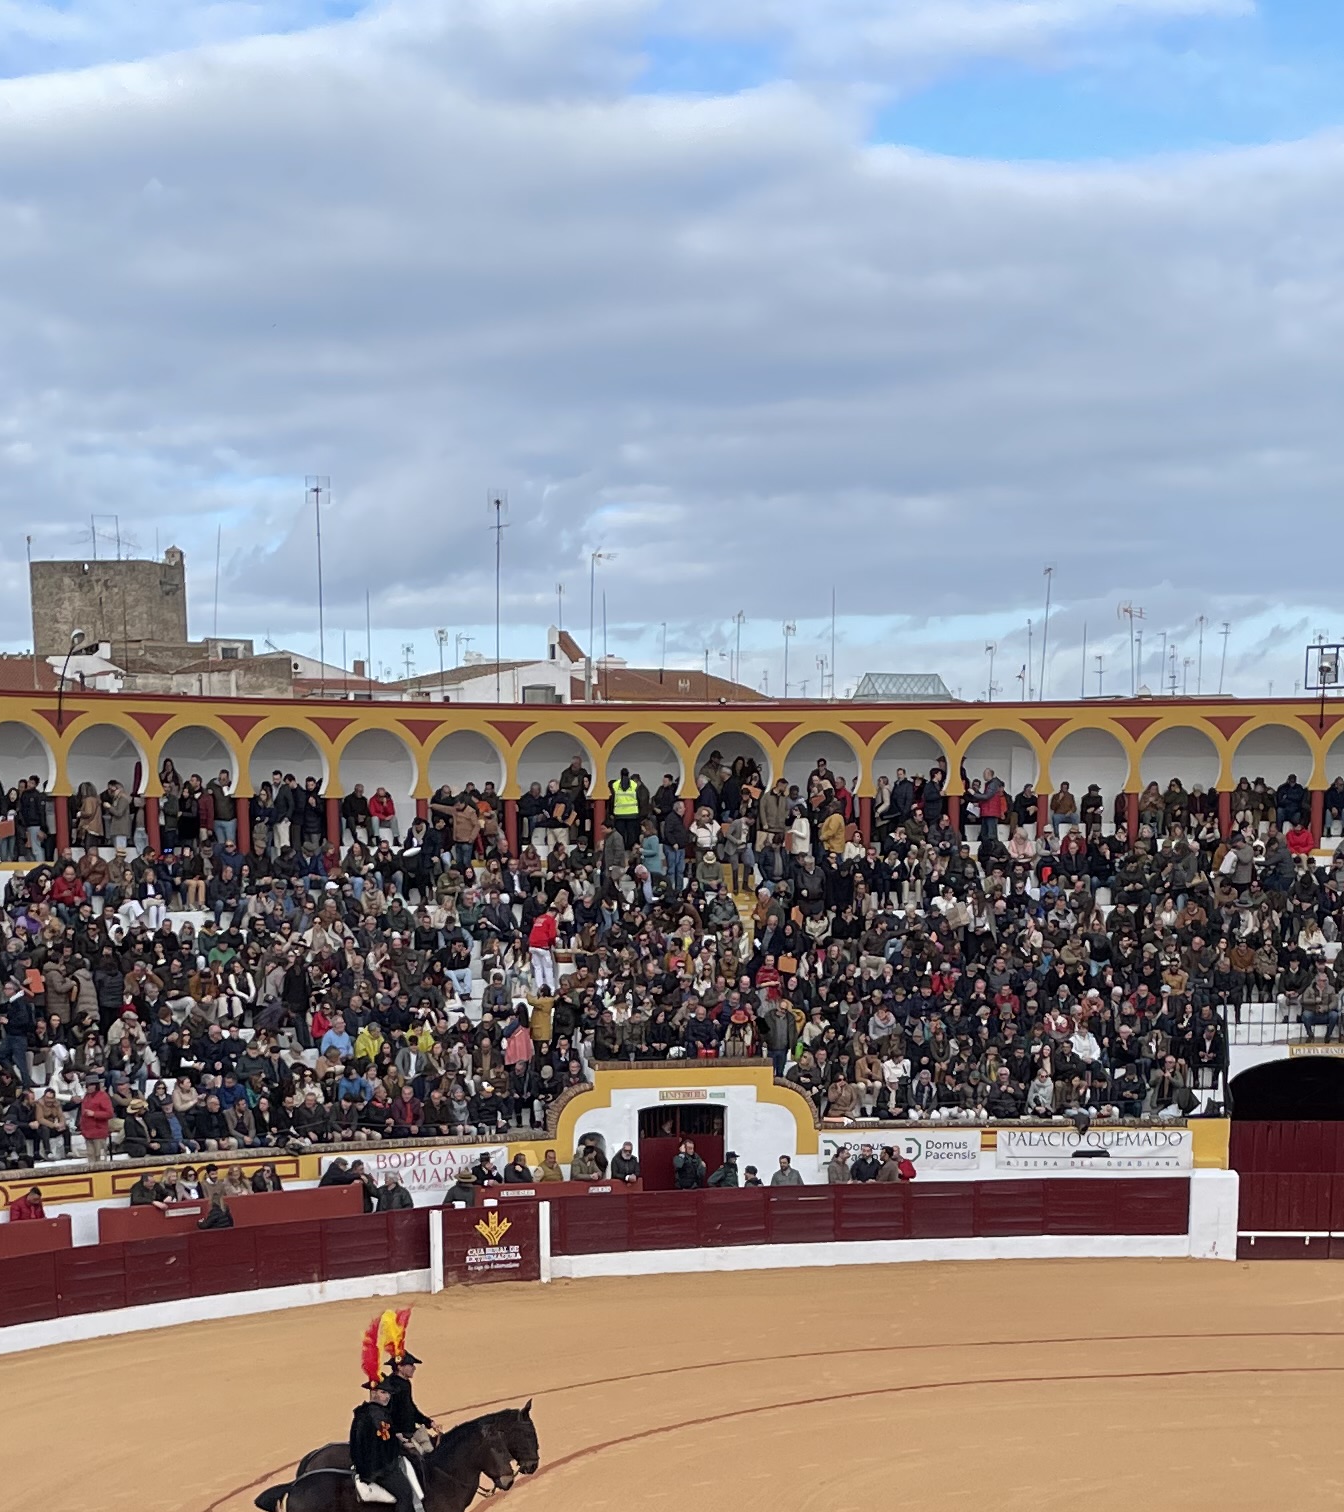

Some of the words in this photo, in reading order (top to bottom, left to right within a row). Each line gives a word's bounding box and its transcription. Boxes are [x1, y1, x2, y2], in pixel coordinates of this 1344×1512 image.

[925, 1140, 968, 1150] Domus
[1007, 1131, 1082, 1147] PALACIO
[1086, 1131, 1183, 1150] QUEMADO
[376, 1150, 457, 1169] BODEGA
[925, 1150, 977, 1161] Pacensis
